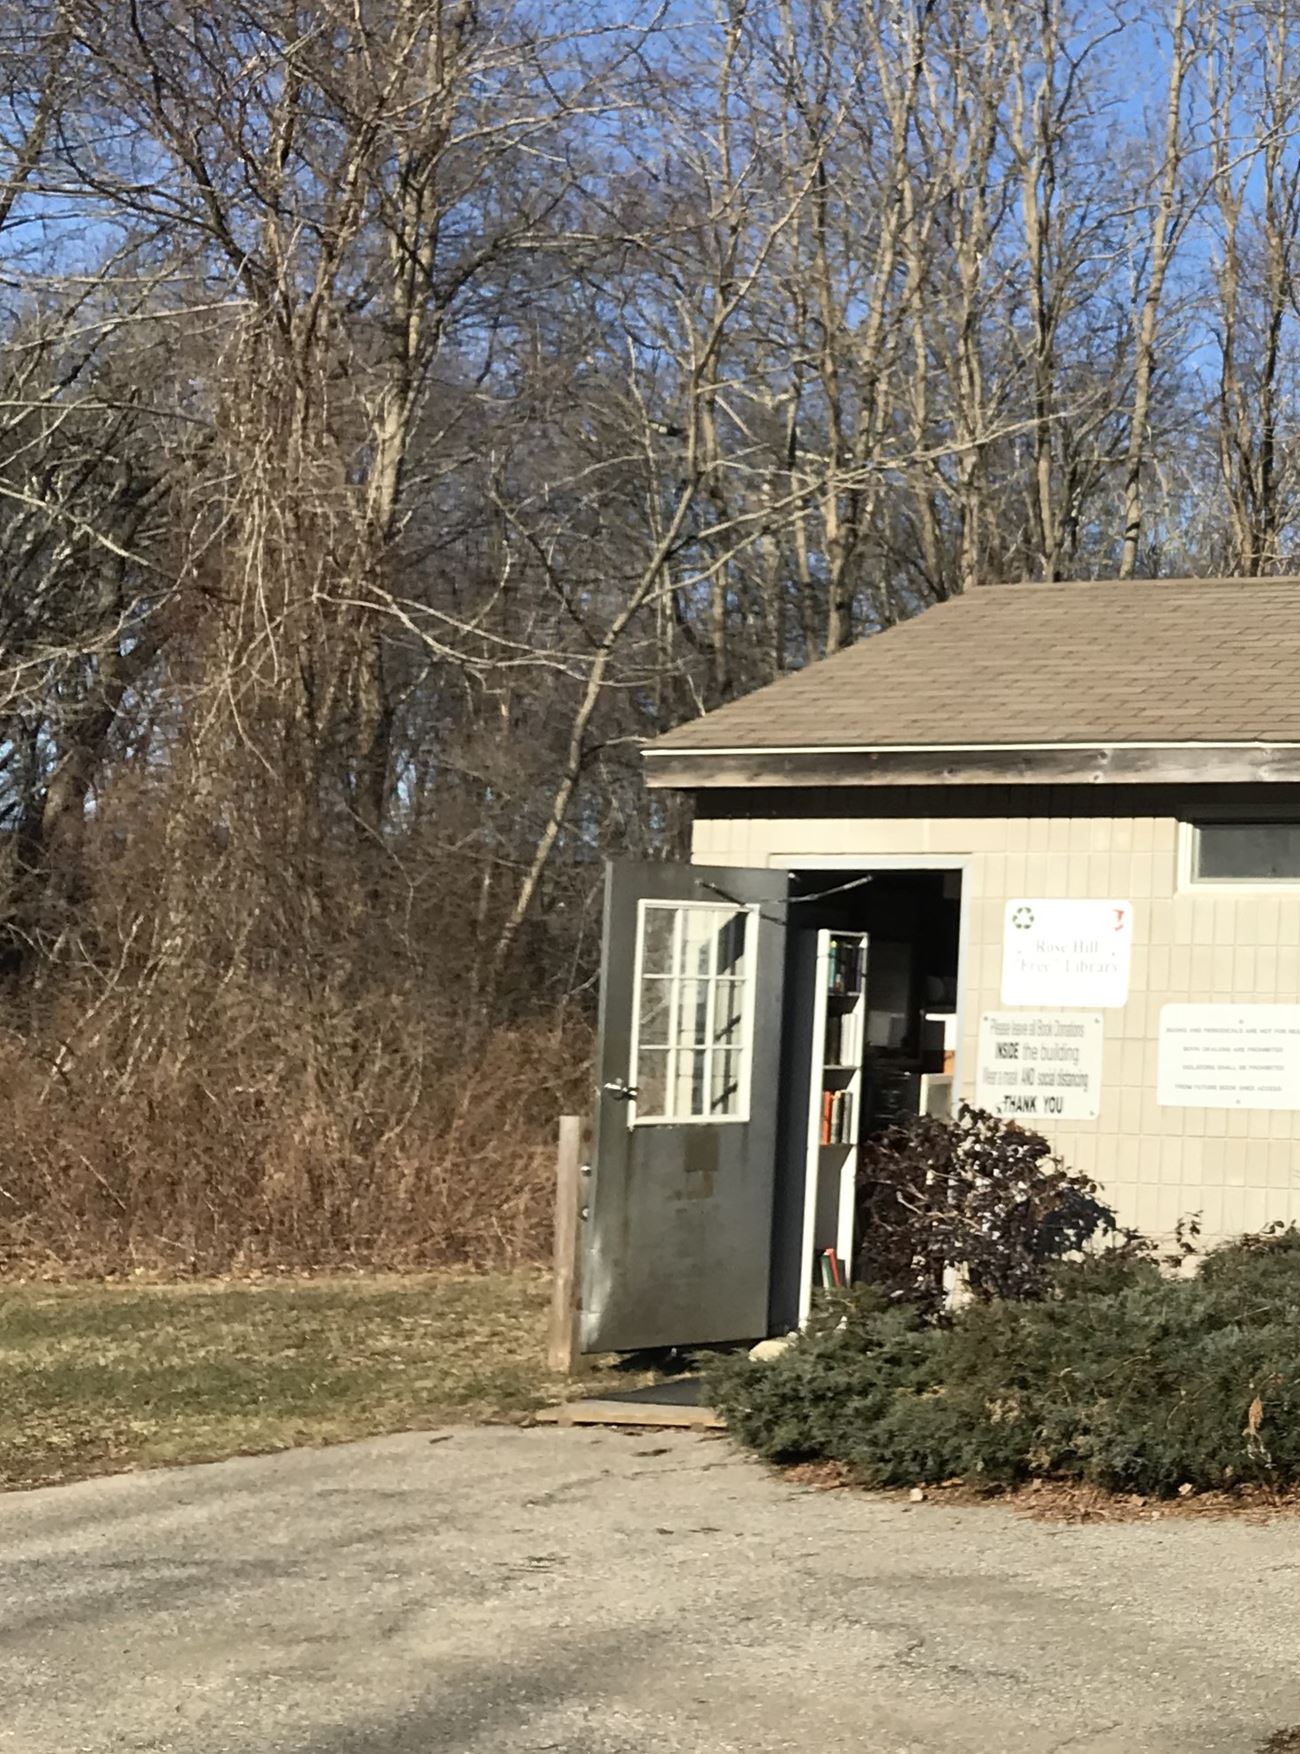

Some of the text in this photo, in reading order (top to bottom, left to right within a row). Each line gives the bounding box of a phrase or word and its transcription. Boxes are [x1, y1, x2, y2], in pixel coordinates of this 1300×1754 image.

[1035, 939, 1099, 954] Rose Hill
[1065, 958, 1119, 976] Library
[1037, 1019, 1053, 1037] Book
[995, 1041, 1080, 1066] INSIDE the building
[1021, 1067, 1036, 1086] AND
[1037, 1068, 1055, 1087] social
[1056, 1068, 1089, 1093] distancing
[1003, 1095, 1064, 1114] THANK YOU
